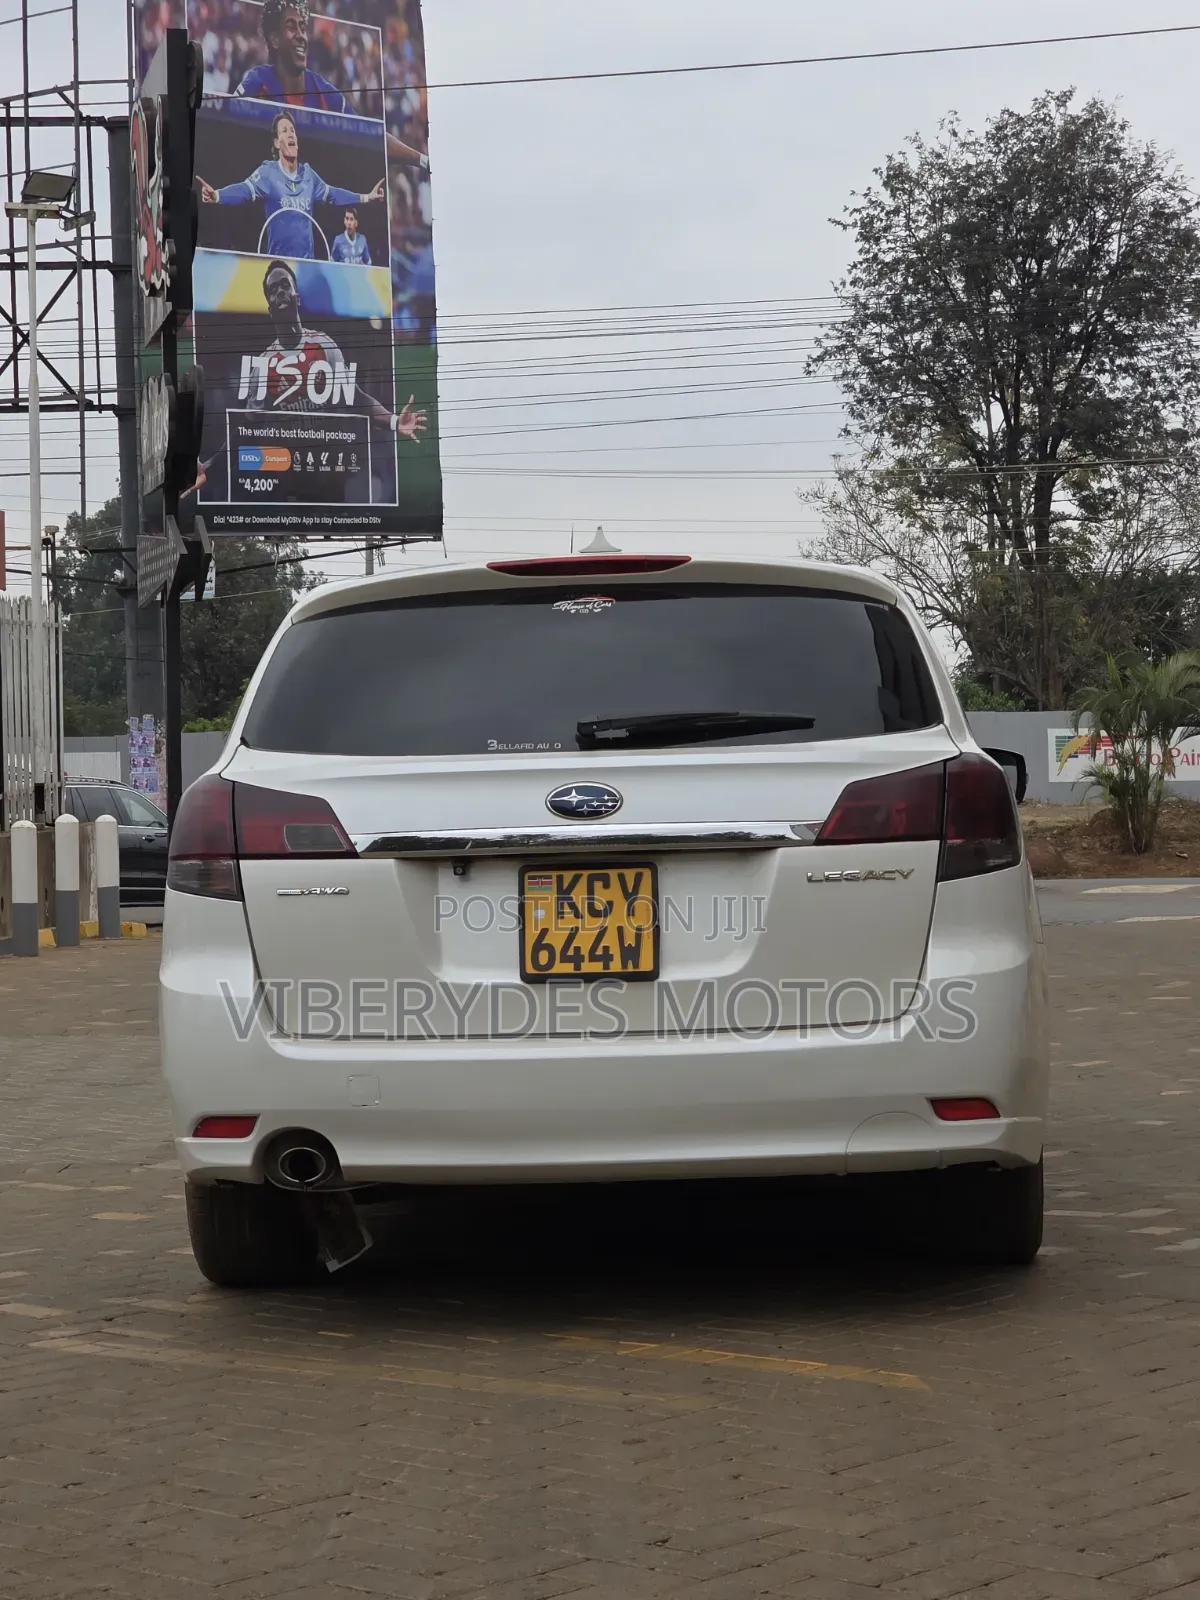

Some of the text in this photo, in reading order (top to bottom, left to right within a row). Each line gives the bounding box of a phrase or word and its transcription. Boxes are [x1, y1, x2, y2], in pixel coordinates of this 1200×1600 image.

[306, 360, 357, 405] ON
[237, 426, 356, 443] The world's best football package
[241, 454, 288, 464] DStv Compact
[244, 478, 273, 492] 4,200
[213, 515, 226, 523] Dial
[252, 515, 280, 523] Download
[302, 516, 314, 525] App
[321, 517, 333, 526] stay
[333, 516, 362, 524] Connected
[369, 516, 382, 524] DStv
[806, 868, 915, 883] LEGACY
[555, 871, 644, 920] KCY
[530, 925, 643, 972] 644W
